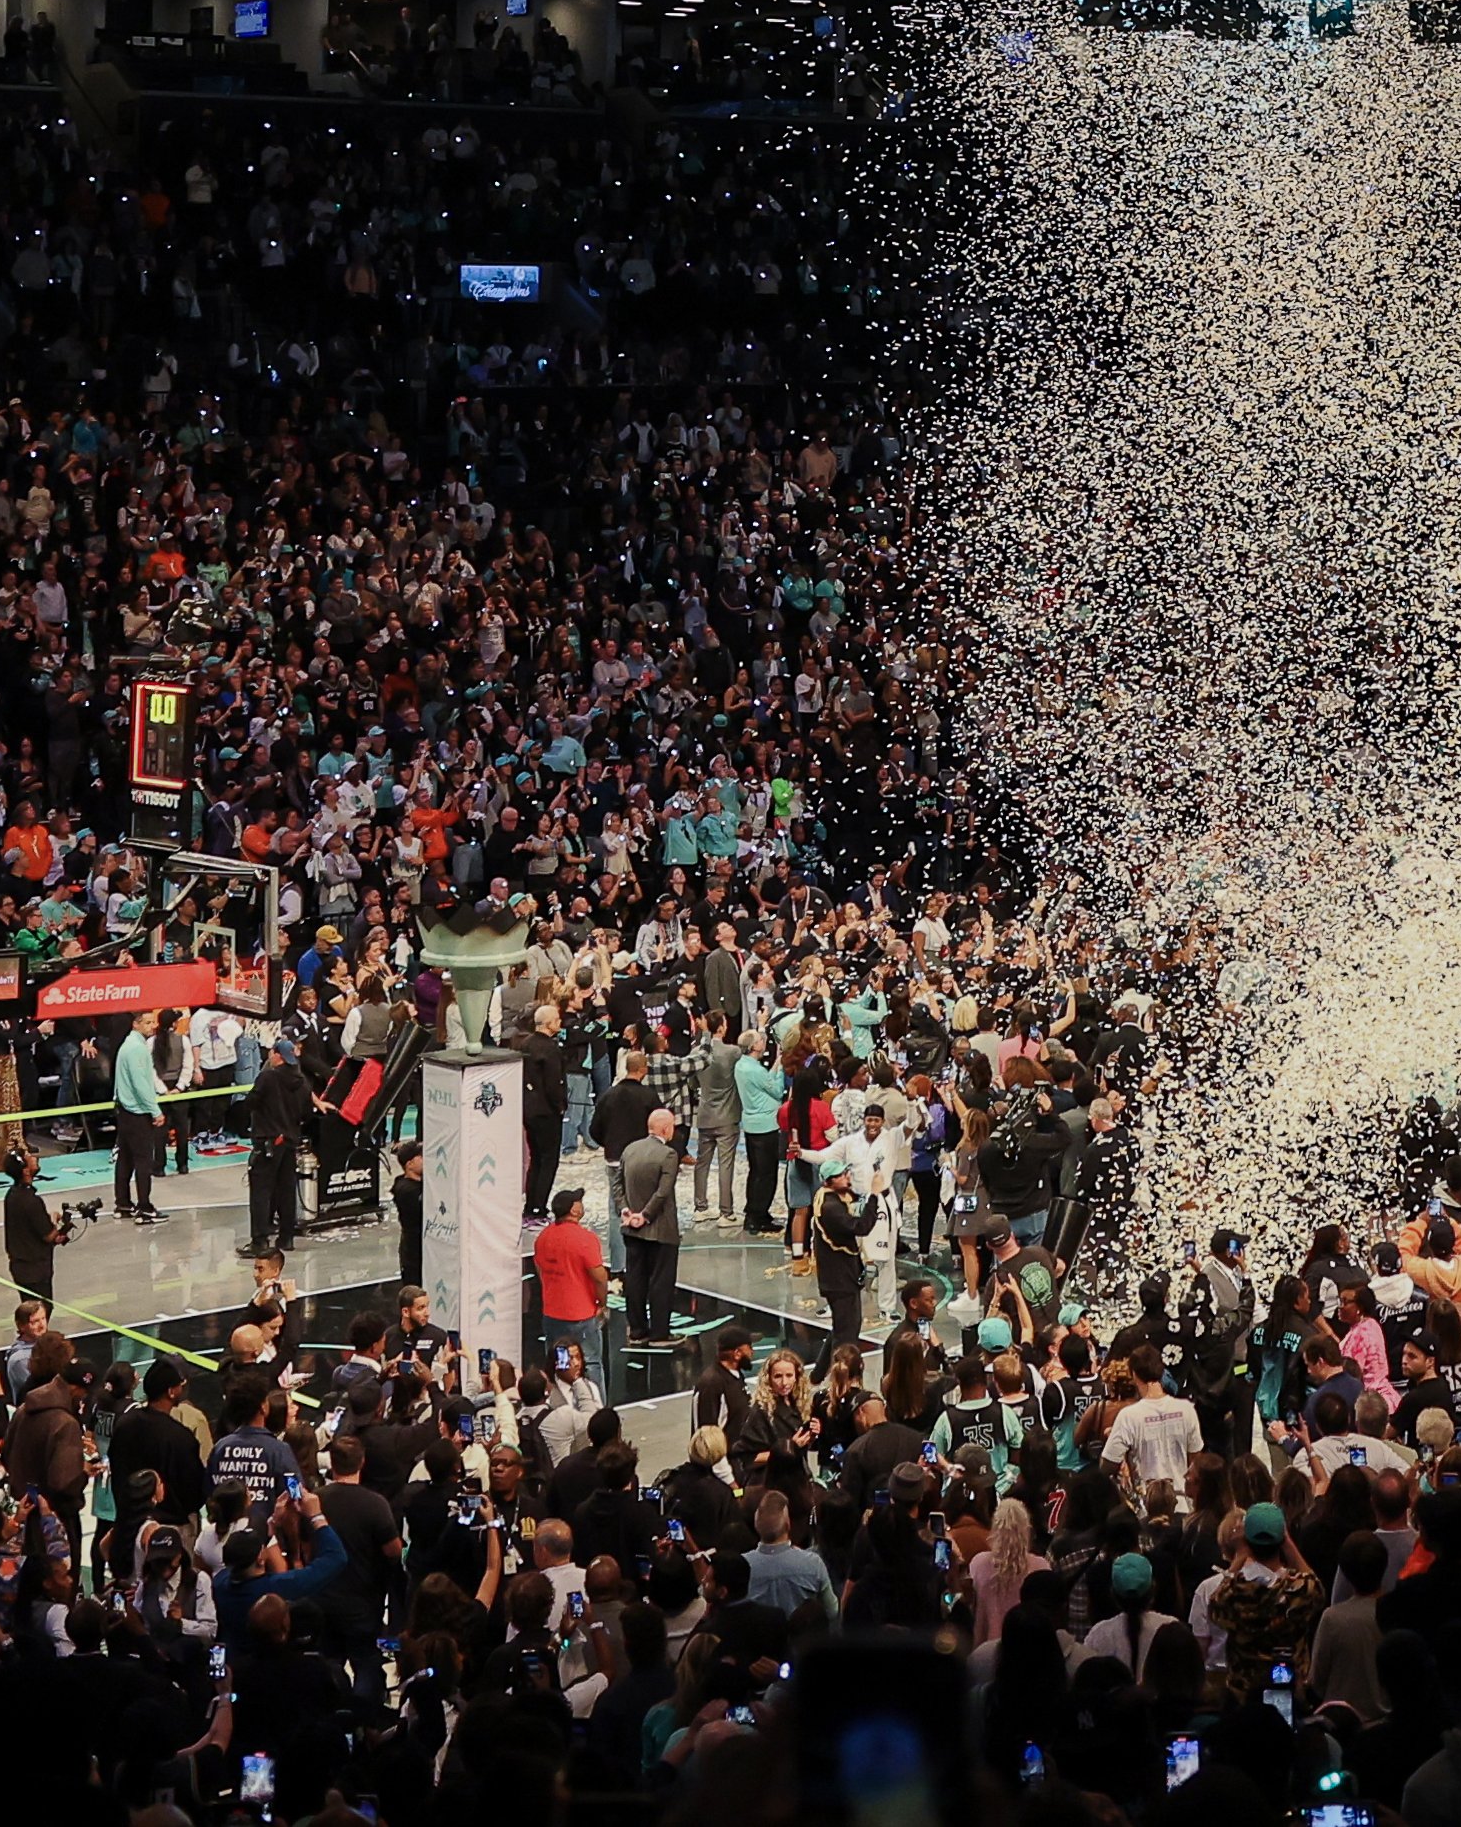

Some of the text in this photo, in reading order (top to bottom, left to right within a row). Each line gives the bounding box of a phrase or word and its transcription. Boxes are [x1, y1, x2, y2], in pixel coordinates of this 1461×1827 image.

[150, 694, 177, 724] 0.0
[145, 792, 180, 810] TISSOT
[1379, 1300, 1424, 1324] Yankees
[963, 1422, 993, 1449] 35
[224, 1446, 263, 1458] I ONLY
[219, 1461, 268, 1473] WANT TO
